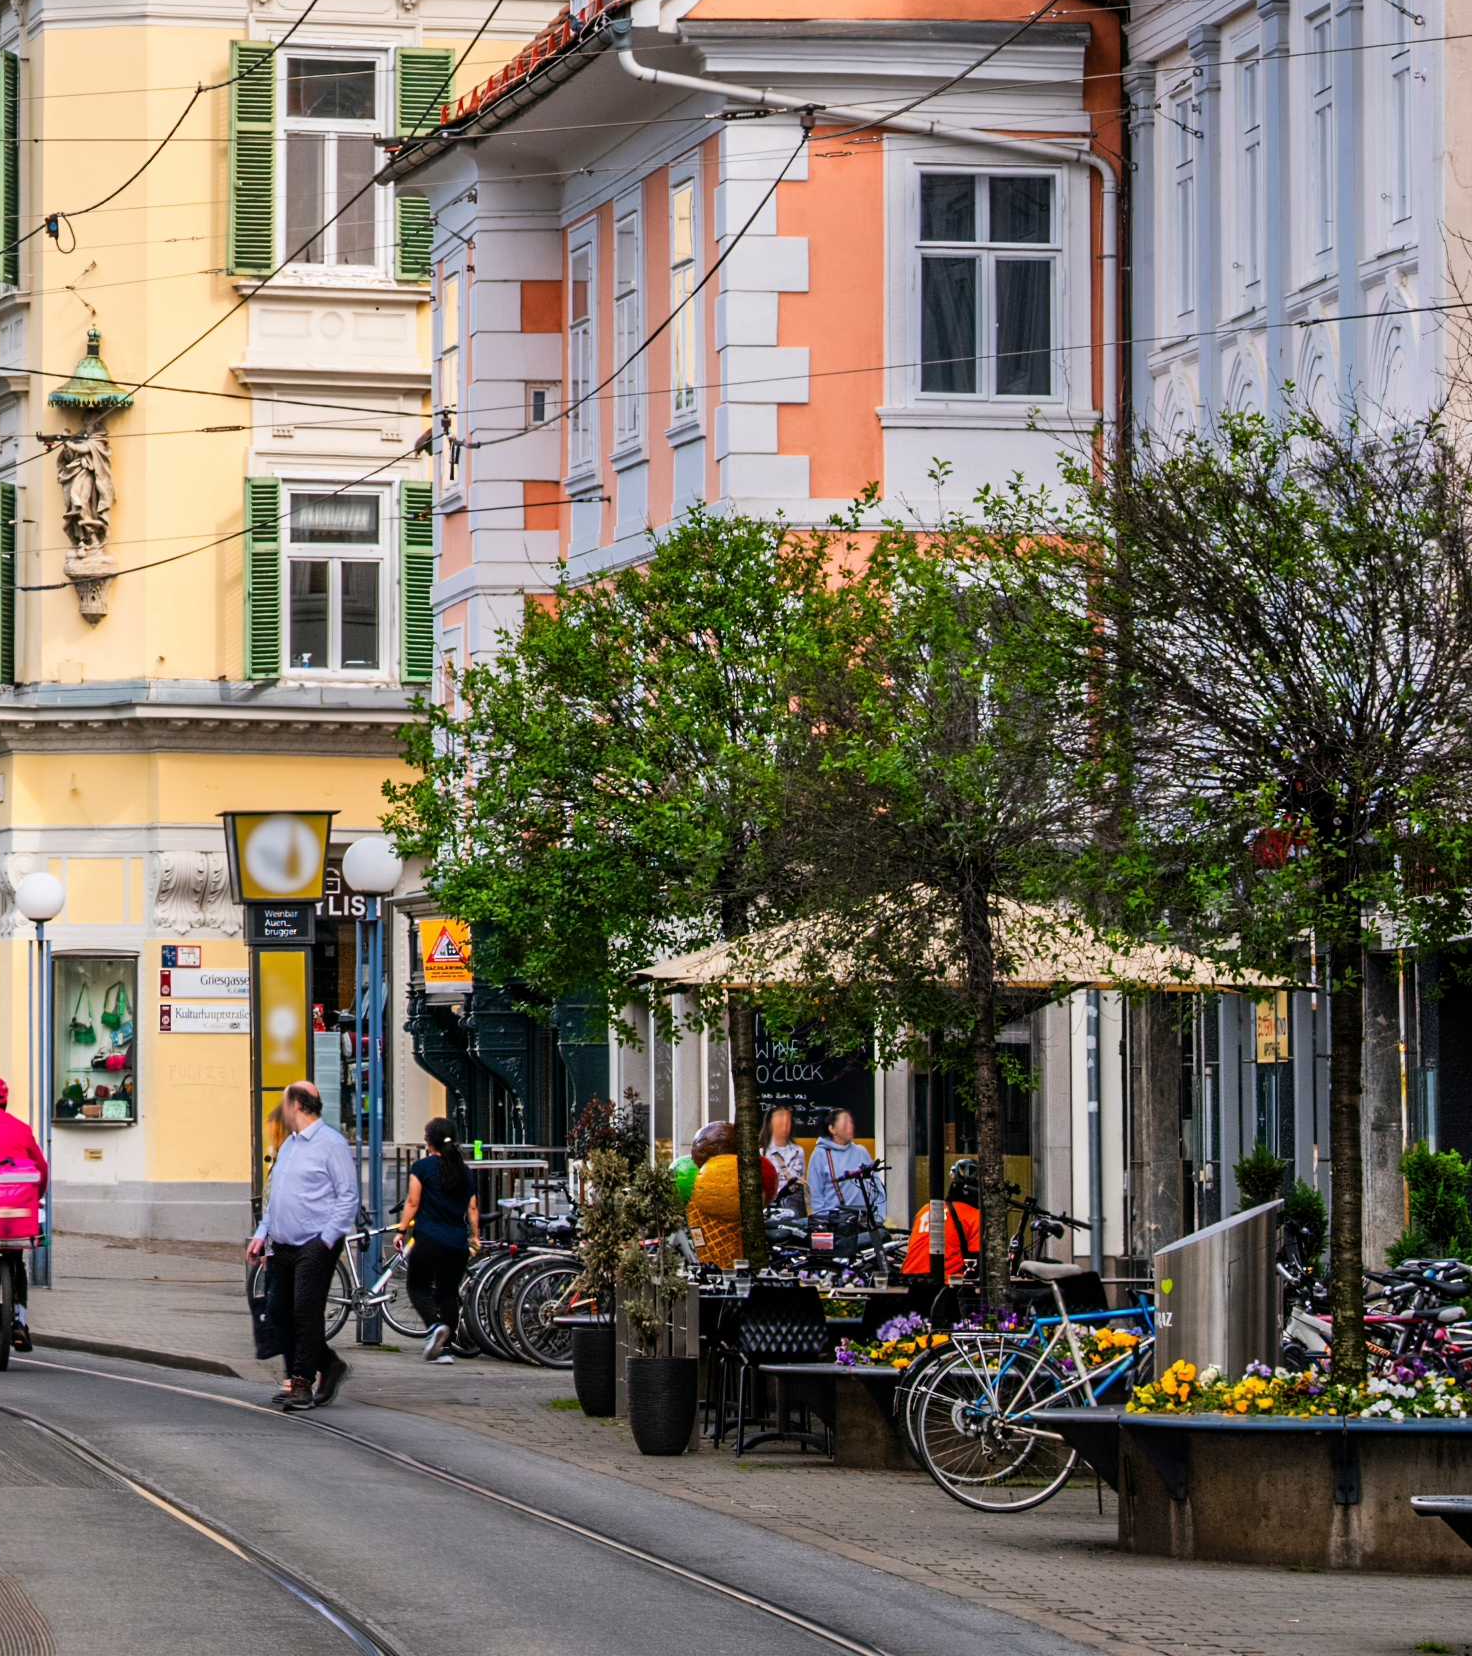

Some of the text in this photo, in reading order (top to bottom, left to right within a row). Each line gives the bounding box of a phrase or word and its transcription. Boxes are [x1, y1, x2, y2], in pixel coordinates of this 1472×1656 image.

[264, 910, 299, 918] Weinbar
[264, 928, 297, 937] brugger
[200, 974, 250, 987] Griesgasse
[756, 1064, 823, 1084] O'CLOCK
